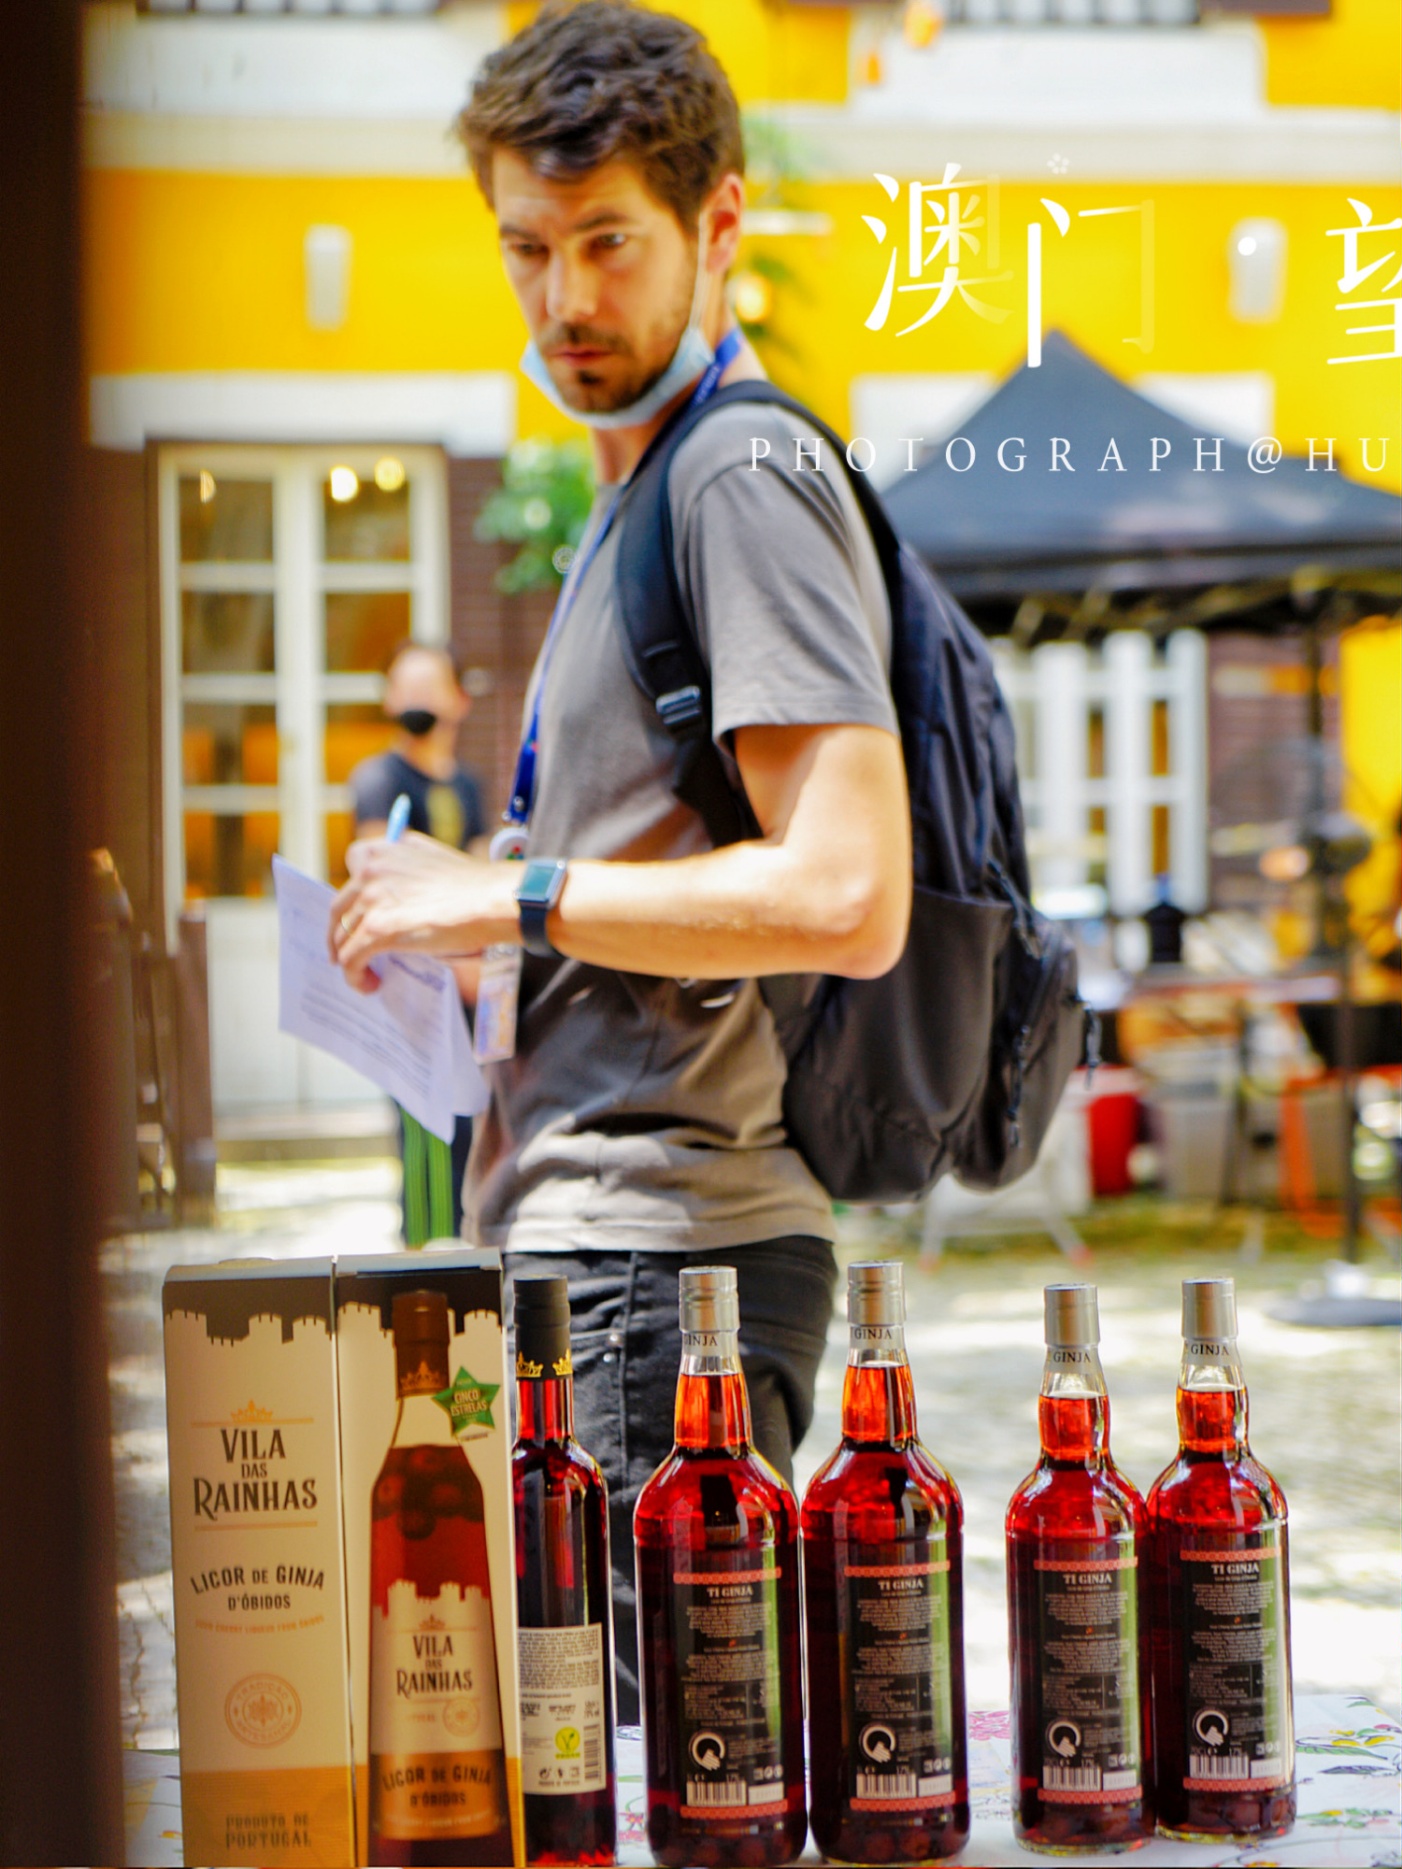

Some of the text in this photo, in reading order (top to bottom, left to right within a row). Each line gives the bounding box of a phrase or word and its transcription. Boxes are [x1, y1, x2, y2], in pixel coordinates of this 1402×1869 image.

[854, 1327, 893, 1340] GINJA
[1190, 1343, 1230, 1356] GINJA
[1053, 1352, 1092, 1364] GINJA
[220, 1428, 287, 1463] VILA
[241, 1463, 268, 1479] DAS
[193, 1477, 318, 1522] RAINHAS
[1211, 1563, 1259, 1575] TI GINJA
[190, 1564, 325, 1595] LICOR DE GINJA
[878, 1578, 924, 1591] TI GINJA
[1063, 1573, 1112, 1585] TI GINJA
[707, 1585, 754, 1598] TI GINJA
[413, 1635, 453, 1659] VILA
[396, 1669, 473, 1699] RAINHAS
[382, 1766, 424, 1791] LICOR
[226, 1831, 312, 1849] PORTUGAL
